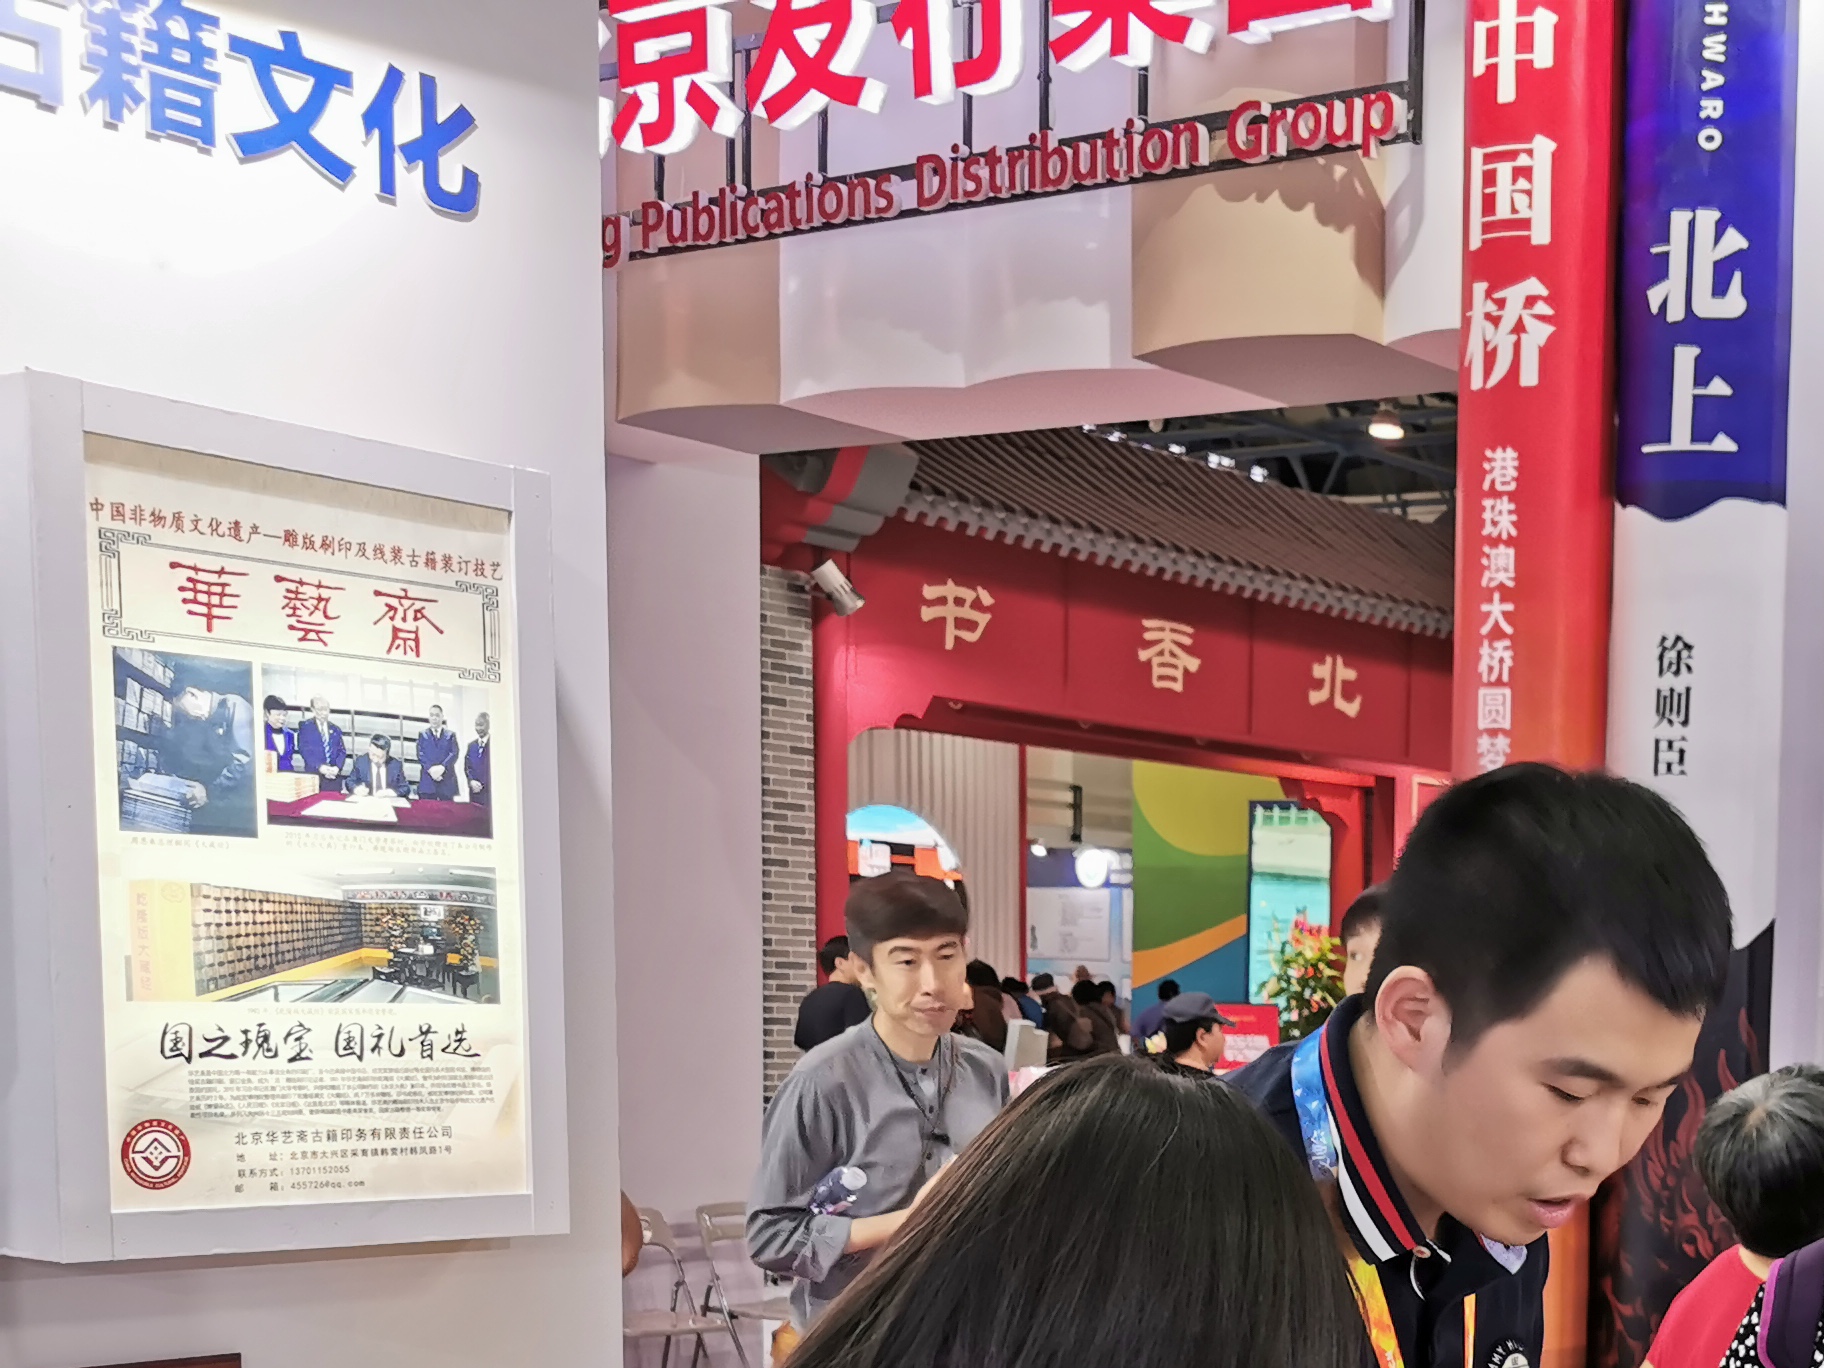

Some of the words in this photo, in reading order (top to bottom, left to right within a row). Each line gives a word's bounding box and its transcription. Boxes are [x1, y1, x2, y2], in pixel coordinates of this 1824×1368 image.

[641, 175, 896, 251] Publications
[916, 119, 1200, 203] Distribution
[1227, 90, 1398, 159] Group
[1464, 5, 1558, 391] 中国桥
[1641, 207, 1749, 454] 北上
[1476, 446, 1519, 773] 港珠澳大桥圆梦
[1651, 633, 1695, 779] 徐则臣
[160, 1021, 314, 1064] 国之瑰宝
[335, 1021, 481, 1063] 国礼首选
